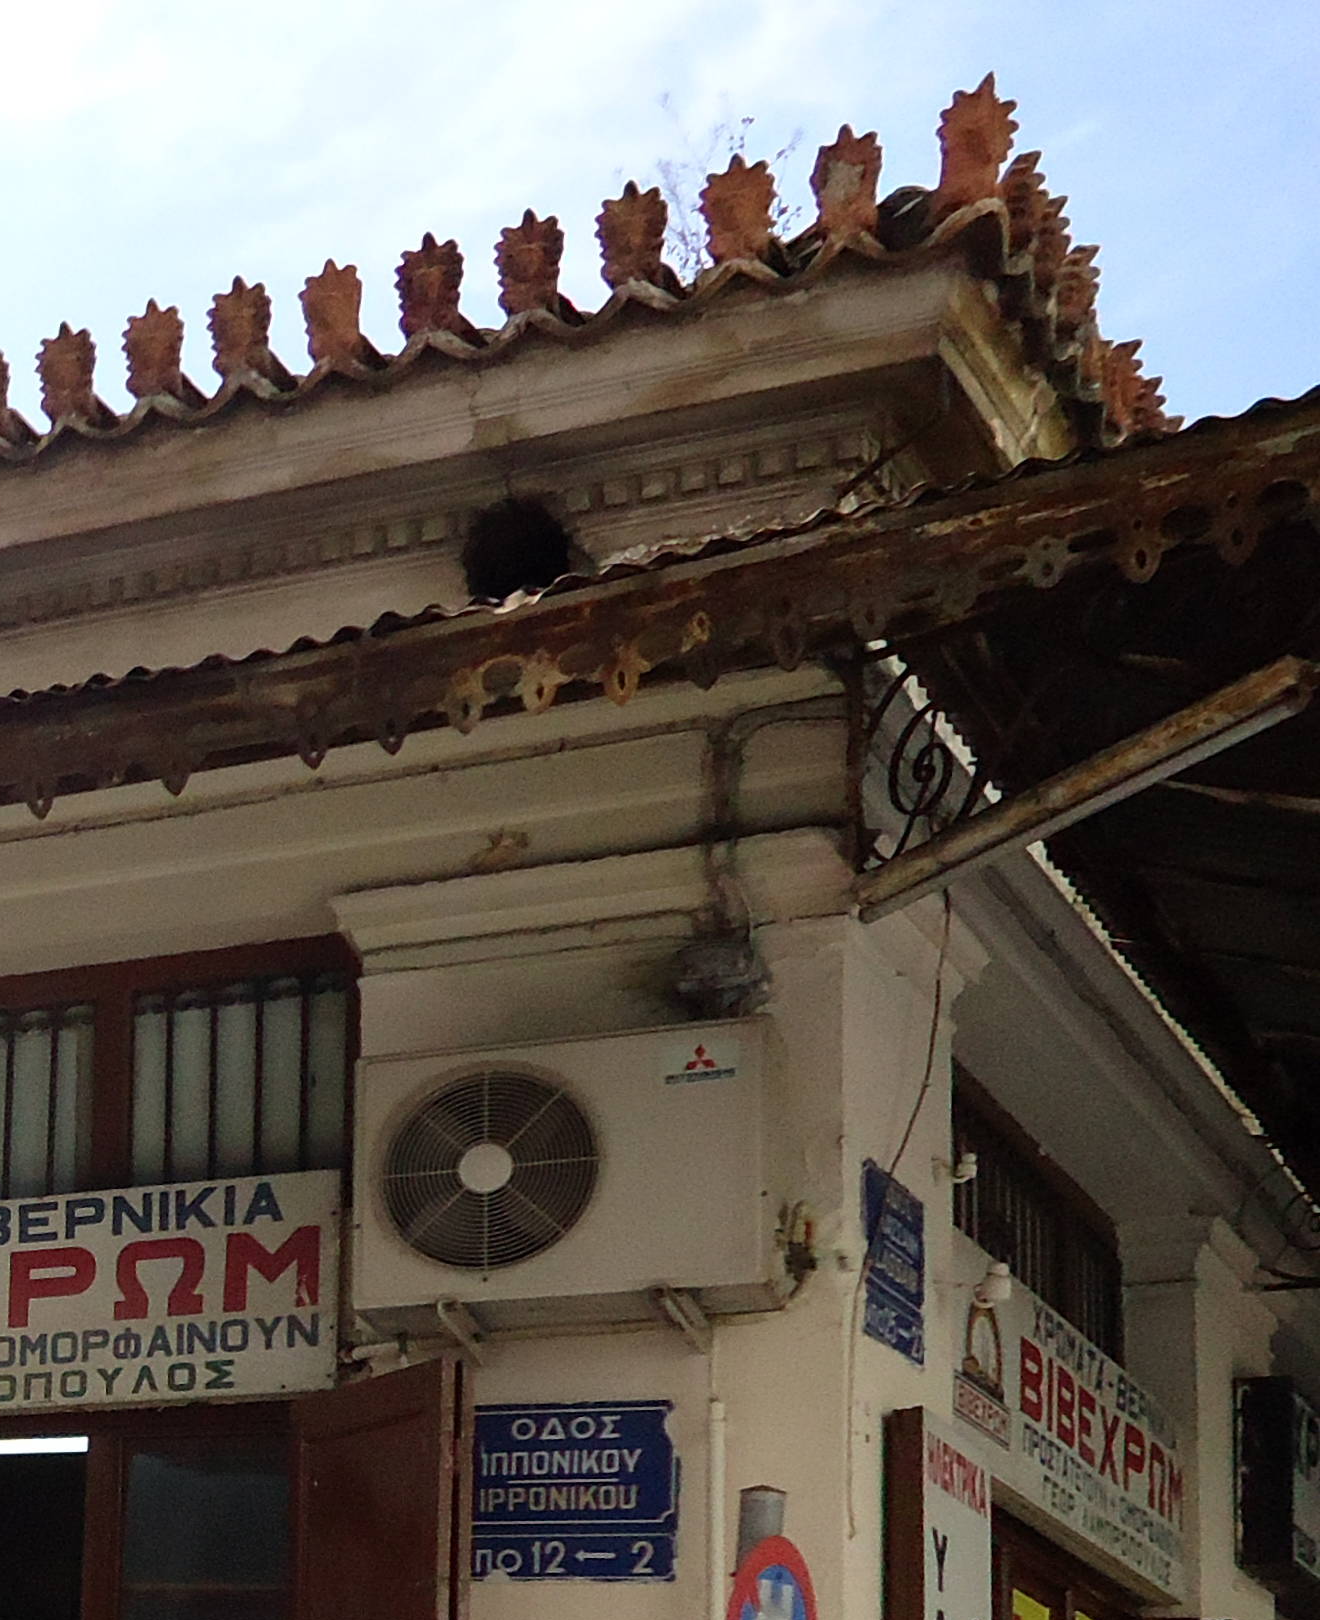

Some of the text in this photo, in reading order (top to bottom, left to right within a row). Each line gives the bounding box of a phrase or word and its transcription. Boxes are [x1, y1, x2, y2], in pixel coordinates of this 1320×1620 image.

[511, 1415, 622, 1440] ΟΔΟΣ
[1020, 1335, 1184, 1533] ΒΙΒΕΧΡΩΜ
[531, 1541, 567, 1574] 12
[631, 1540, 655, 1574] 2
